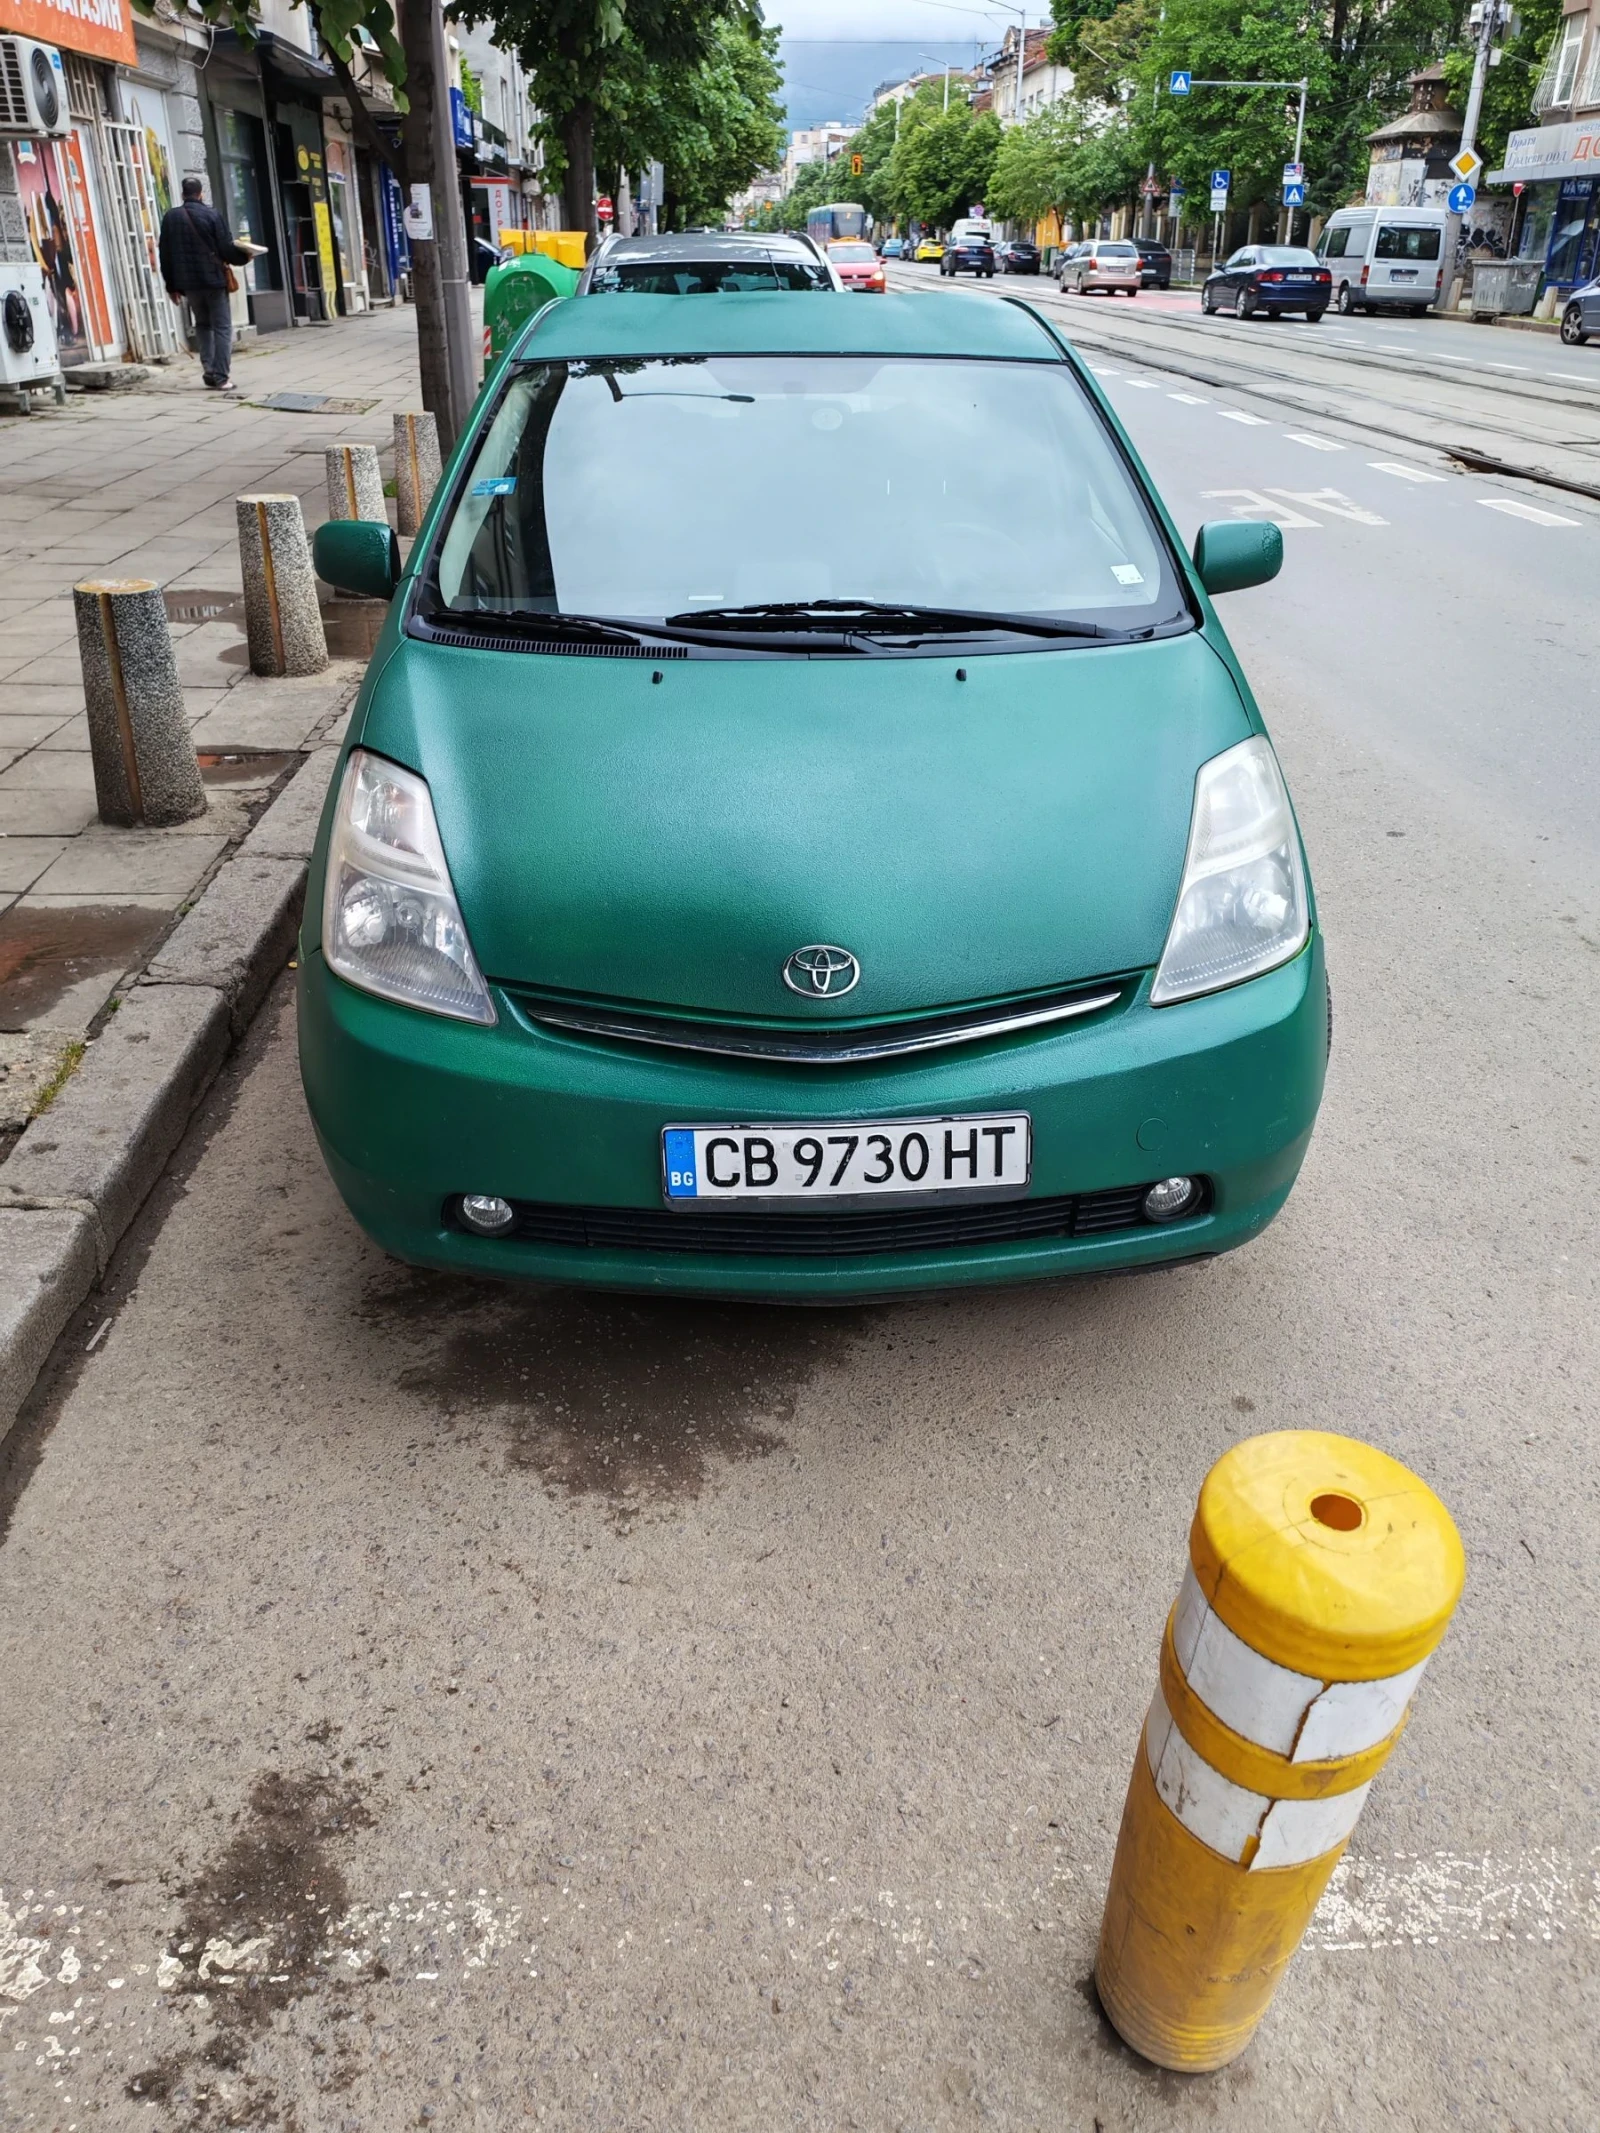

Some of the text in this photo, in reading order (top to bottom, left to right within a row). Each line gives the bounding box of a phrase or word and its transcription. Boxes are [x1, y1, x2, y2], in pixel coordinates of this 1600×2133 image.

[705, 1126, 1016, 1188] CB 9730 HT
[671, 1171, 694, 1187] BG
